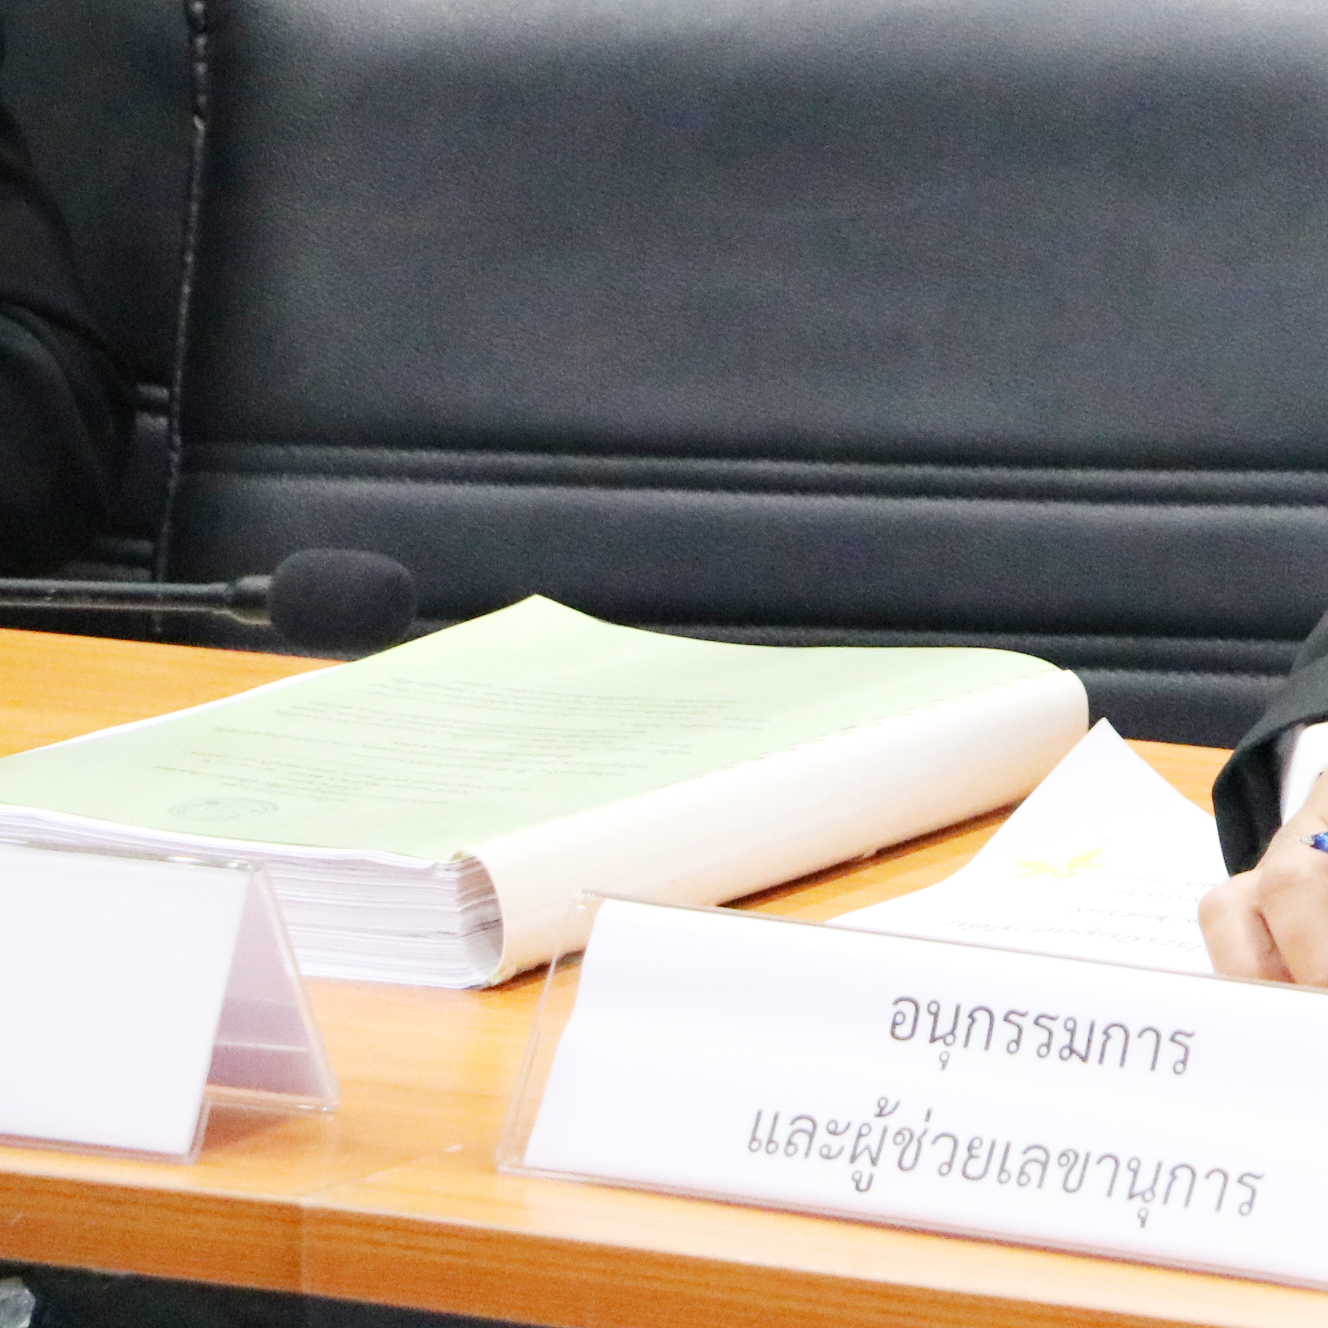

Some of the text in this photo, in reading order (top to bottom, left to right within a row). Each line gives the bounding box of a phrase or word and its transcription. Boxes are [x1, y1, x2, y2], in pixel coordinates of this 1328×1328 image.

[890, 996, 1196, 1075] อนุกรรมการ
[747, 1096, 1264, 1229] และผู้ช่วยเลขานุการ
